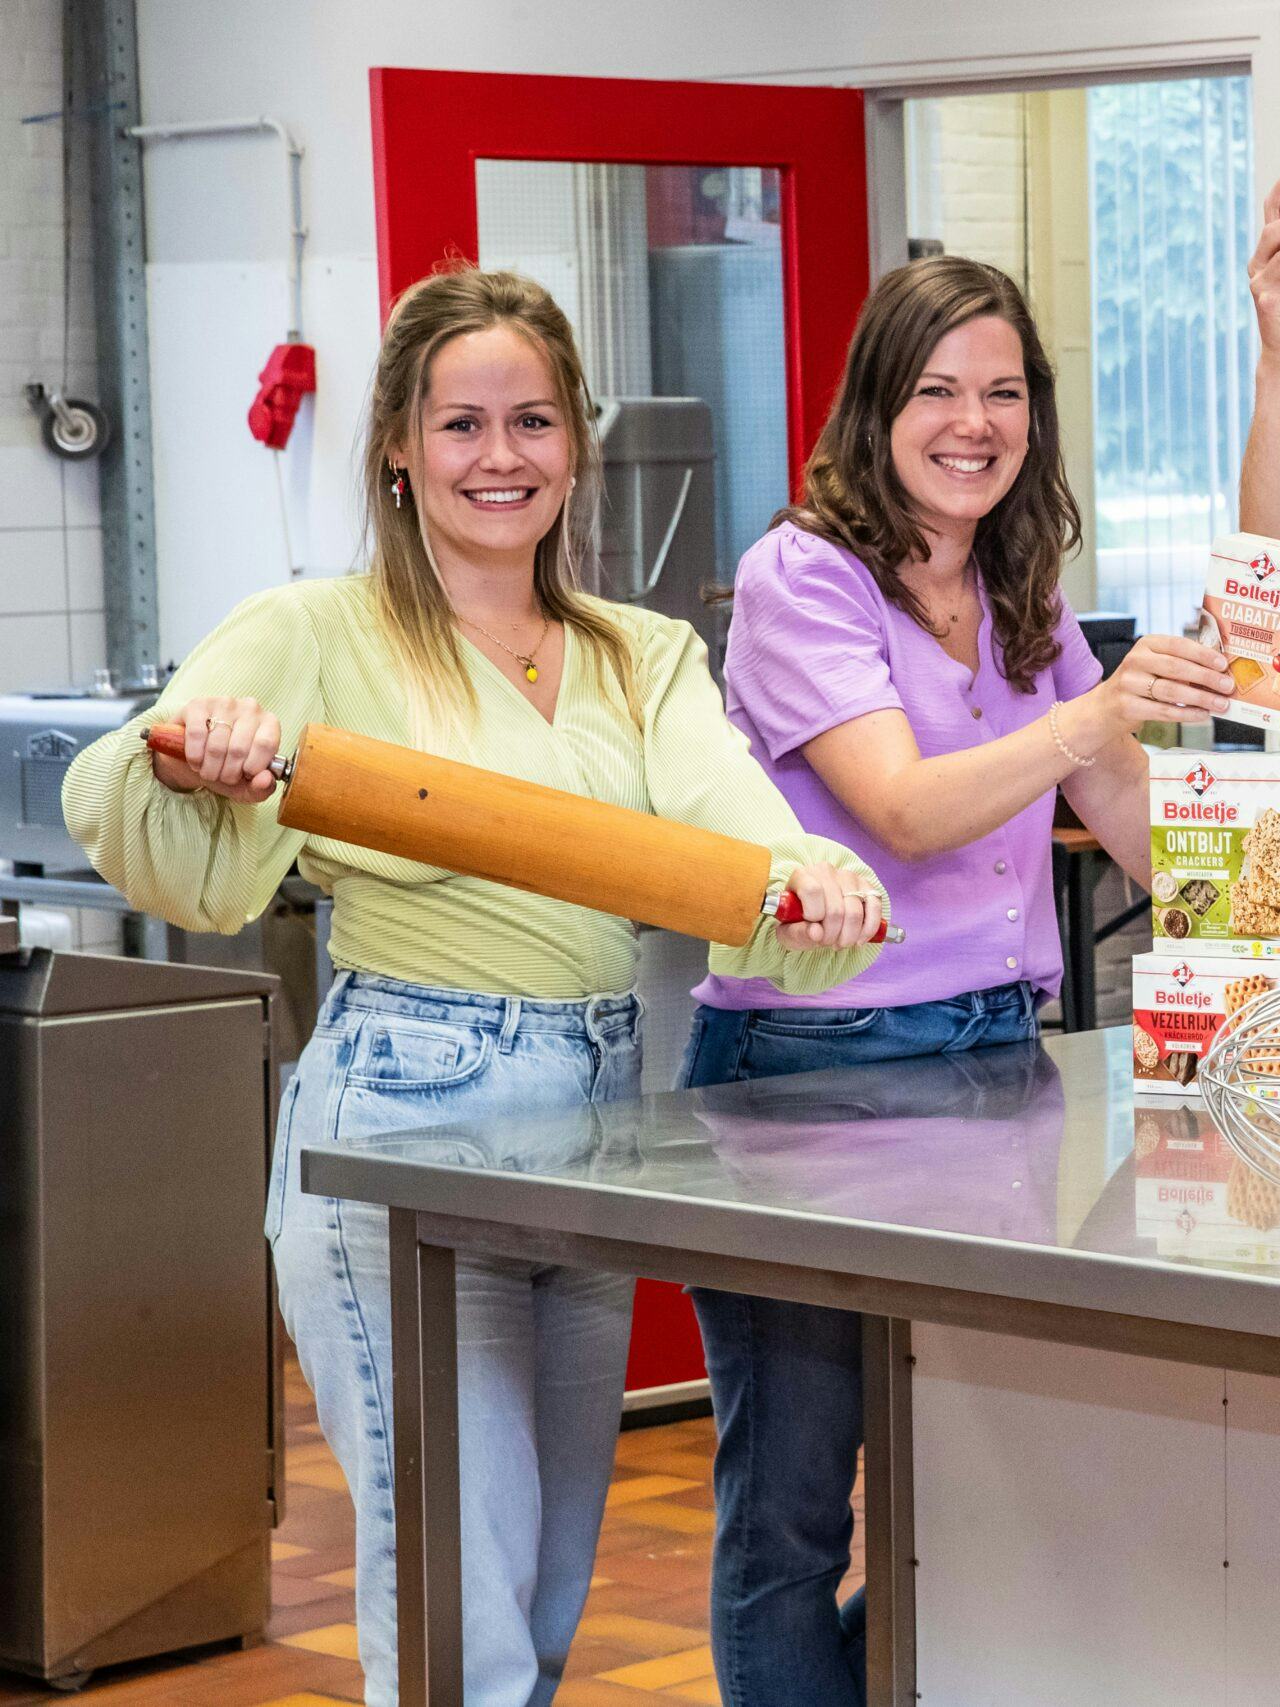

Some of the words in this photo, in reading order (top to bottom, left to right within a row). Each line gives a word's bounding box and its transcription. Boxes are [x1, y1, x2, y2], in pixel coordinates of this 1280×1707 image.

[1230, 624, 1273, 641] TUSSENDOOR
[1164, 802, 1238, 824] Bolletje
[1166, 830, 1233, 854] ONTBIJT
[1176, 855, 1224, 867] CRACKERS
[1156, 990, 1211, 1008] Bolletje
[1151, 1012, 1217, 1032] VEZELRIJK
